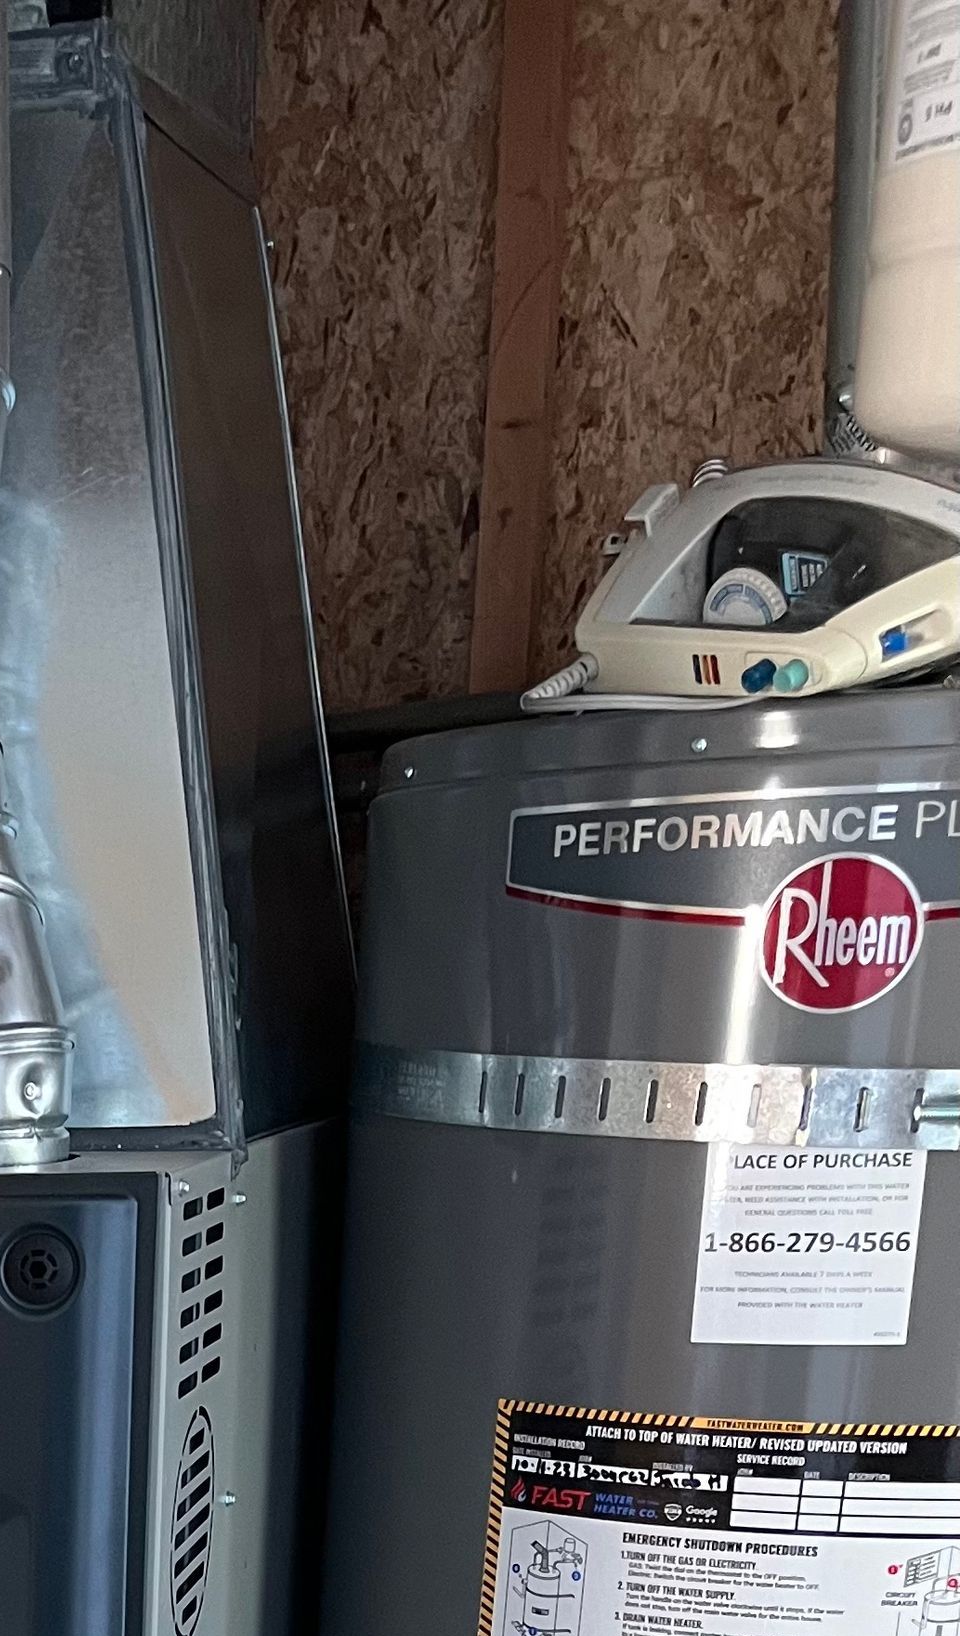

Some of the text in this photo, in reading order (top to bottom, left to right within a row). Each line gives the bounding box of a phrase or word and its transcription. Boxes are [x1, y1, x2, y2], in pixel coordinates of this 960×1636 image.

[554, 805, 898, 857] PERFORMANCE
[773, 860, 911, 988] Rheem
[730, 1152, 912, 1169] LACE OF PURCHASE
[705, 1232, 910, 1253] 1-866-279-4566
[514, 1434, 556, 1446] INSTALLATION
[586, 1425, 908, 1454] ATTACH TO TOP OF WATER HEATER/ REVISED UPDATED VERSION
[737, 1454, 806, 1466] SERVICE RECORD
[530, 1485, 592, 1511] FAST
[595, 1493, 633, 1505] WATER
[594, 1504, 658, 1518] HEATER CO.
[685, 1505, 718, 1518] Google
[622, 1532, 818, 1557] EMERGENCY SHUTDOWN PROCEDURES
[648, 1553, 660, 1562] OFF
[662, 1554, 676, 1564] THE
[678, 1556, 693, 1566] GAS
[695, 1558, 706, 1567] OR
[618, 1581, 736, 1600] 2. TURN OFF THE WATER SUPPLY.
[614, 1612, 703, 1629] 3. DRAIN WATER HEATER.
